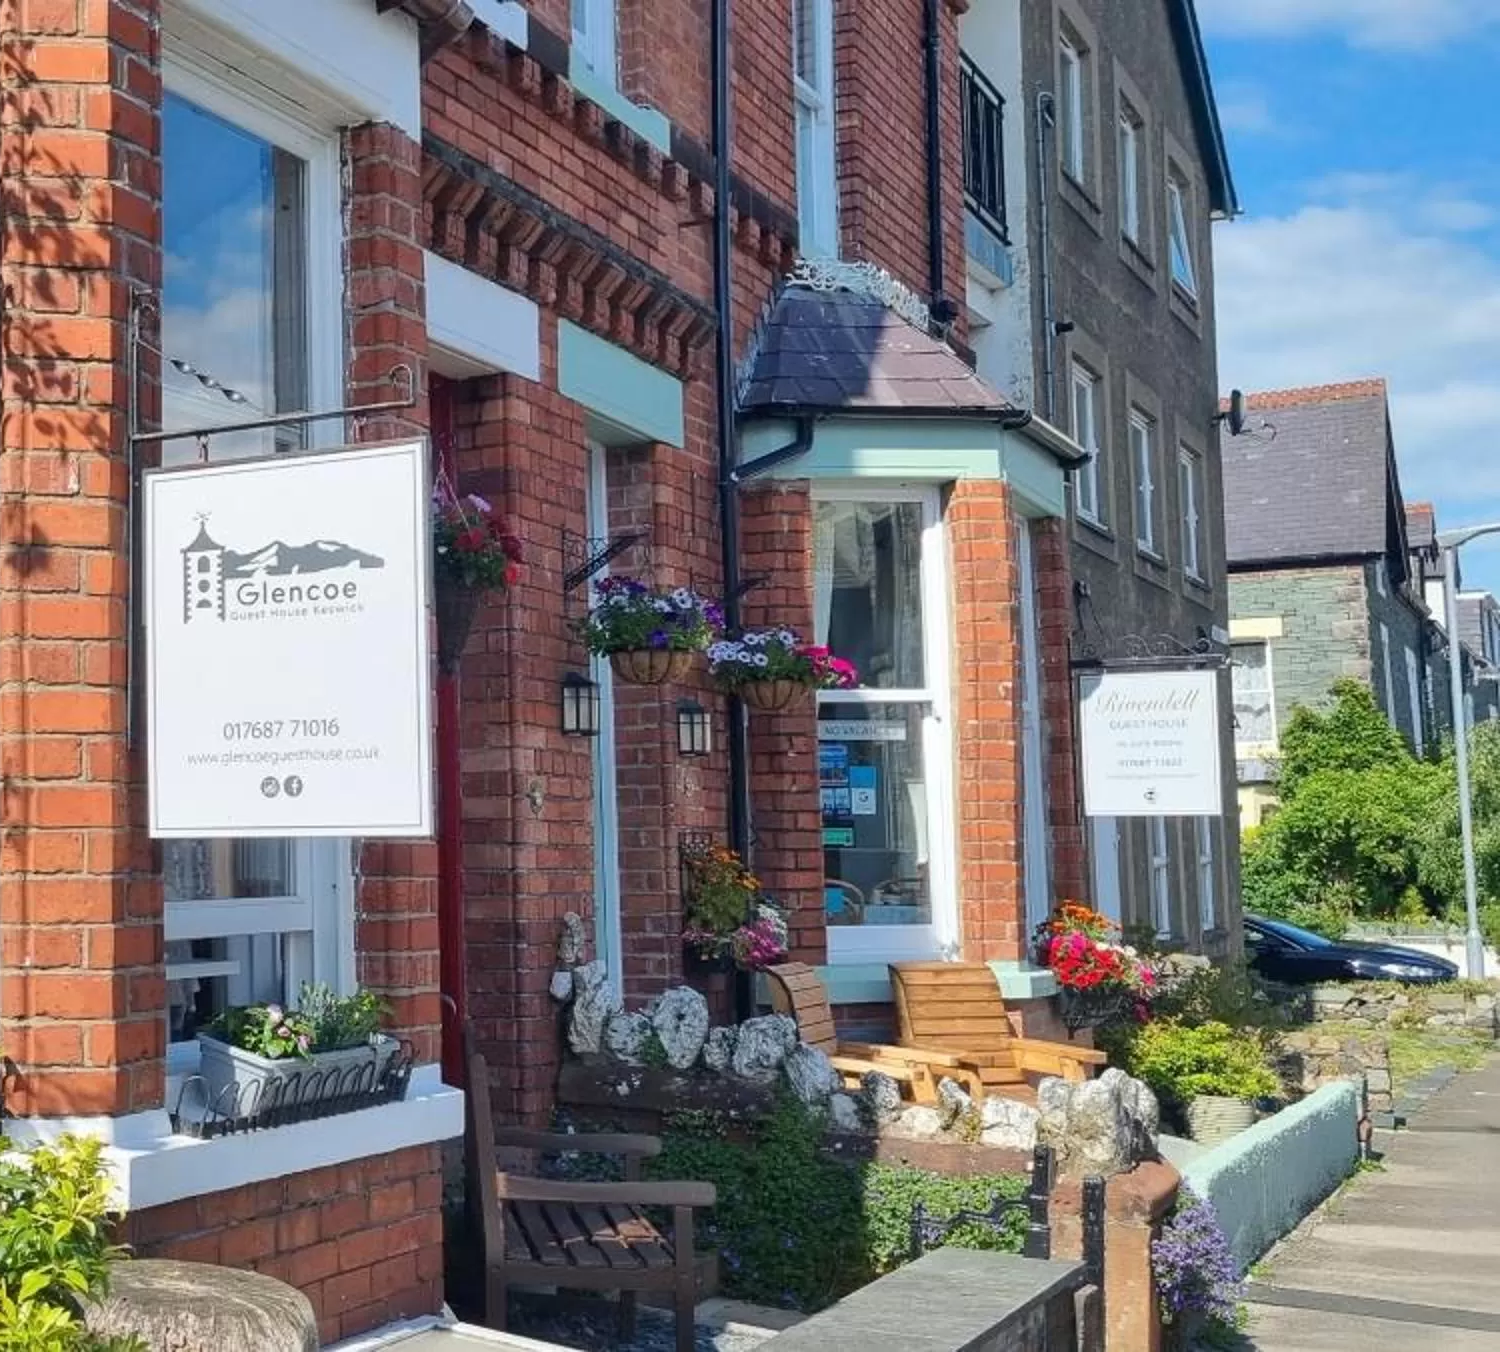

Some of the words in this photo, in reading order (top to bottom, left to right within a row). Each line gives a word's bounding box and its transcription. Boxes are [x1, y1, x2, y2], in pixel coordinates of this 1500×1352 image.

[237, 580, 357, 606] Glencoe
[230, 609, 265, 621] Guest
[271, 607, 307, 617] House
[313, 603, 364, 615] Keswick
[1095, 687, 1200, 713] Rivendell
[223, 721, 284, 741] 017687
[289, 717, 340, 737] 71016
